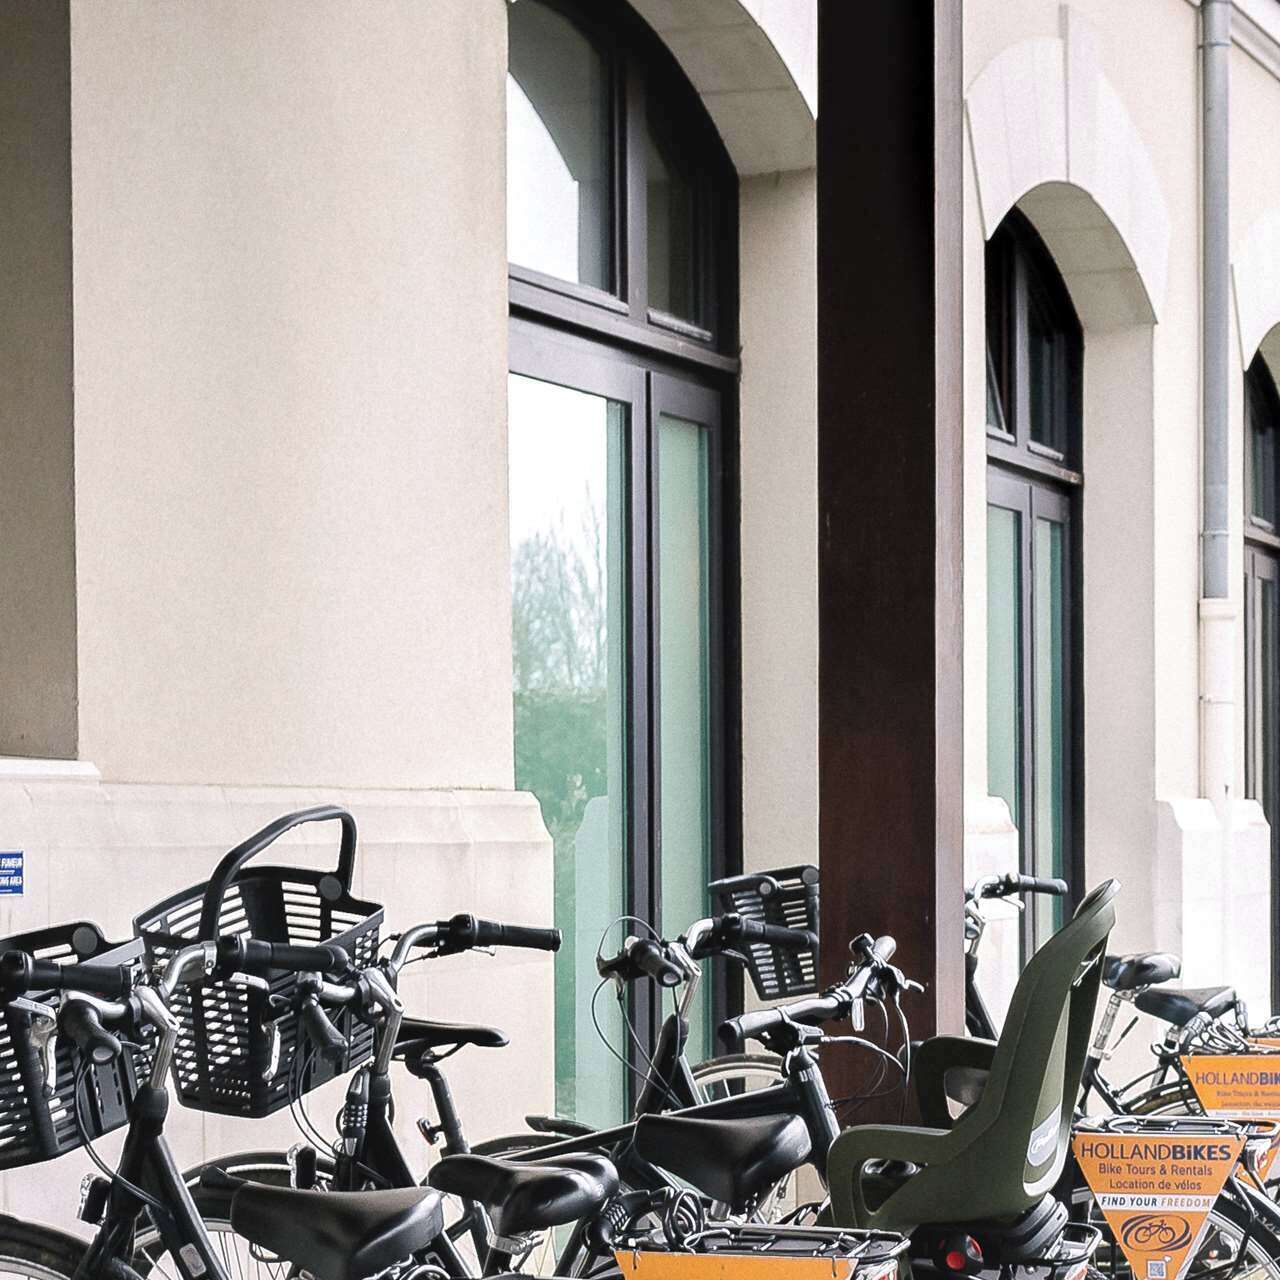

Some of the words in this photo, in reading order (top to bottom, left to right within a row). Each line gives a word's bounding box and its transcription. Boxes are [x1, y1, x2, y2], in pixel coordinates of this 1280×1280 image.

[1098, 1162, 1122, 1175] Bike
[1126, 1163, 1156, 1176] Tours
[1159, 1164, 1167, 1176] &
[1170, 1164, 1213, 1176] Rentals
[1109, 1179, 1155, 1190] Location
[1157, 1179, 1171, 1190] de
[1174, 1179, 1202, 1190] vélos
[1101, 1196, 1126, 1206] FIND
[1130, 1197, 1157, 1207] YOUR
[1161, 1197, 1211, 1208] FREEDOM
